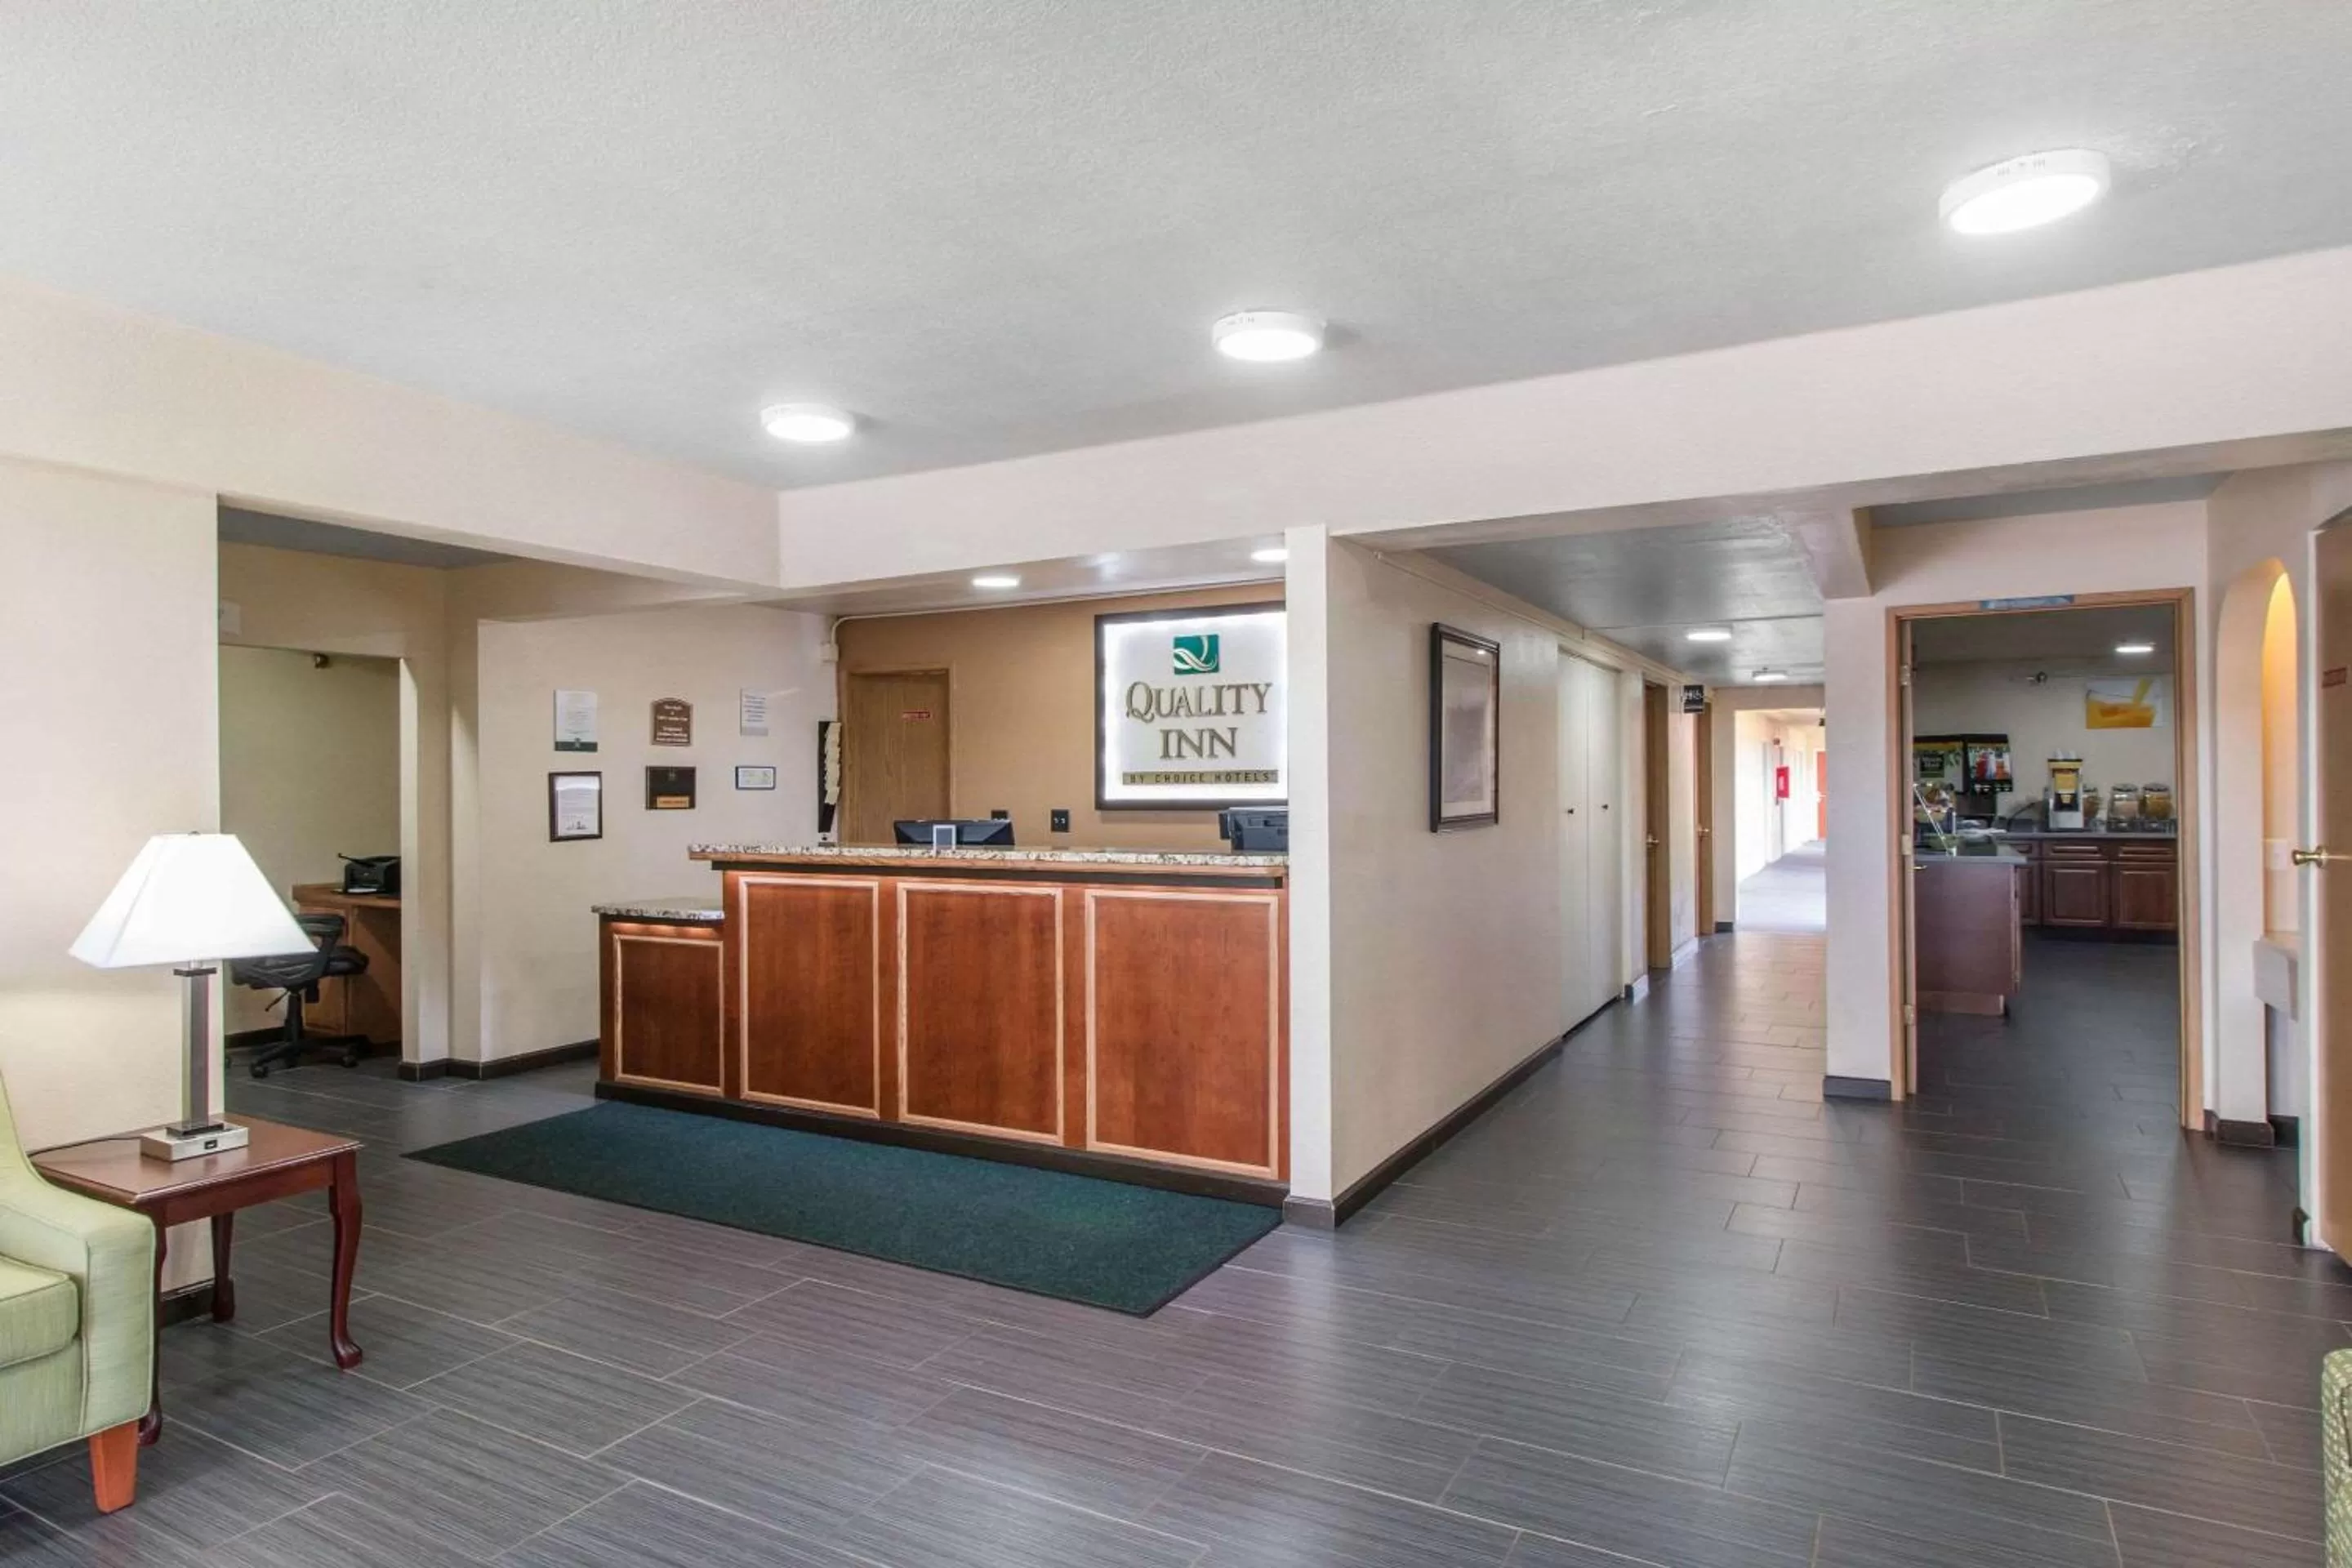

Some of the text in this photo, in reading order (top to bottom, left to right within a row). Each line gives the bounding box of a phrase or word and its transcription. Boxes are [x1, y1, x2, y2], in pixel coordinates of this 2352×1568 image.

[1125, 681, 1272, 724] QUALITY
[1159, 727, 1239, 760] INN
[1129, 772, 1270, 784] BY CHOICE HOTELS
